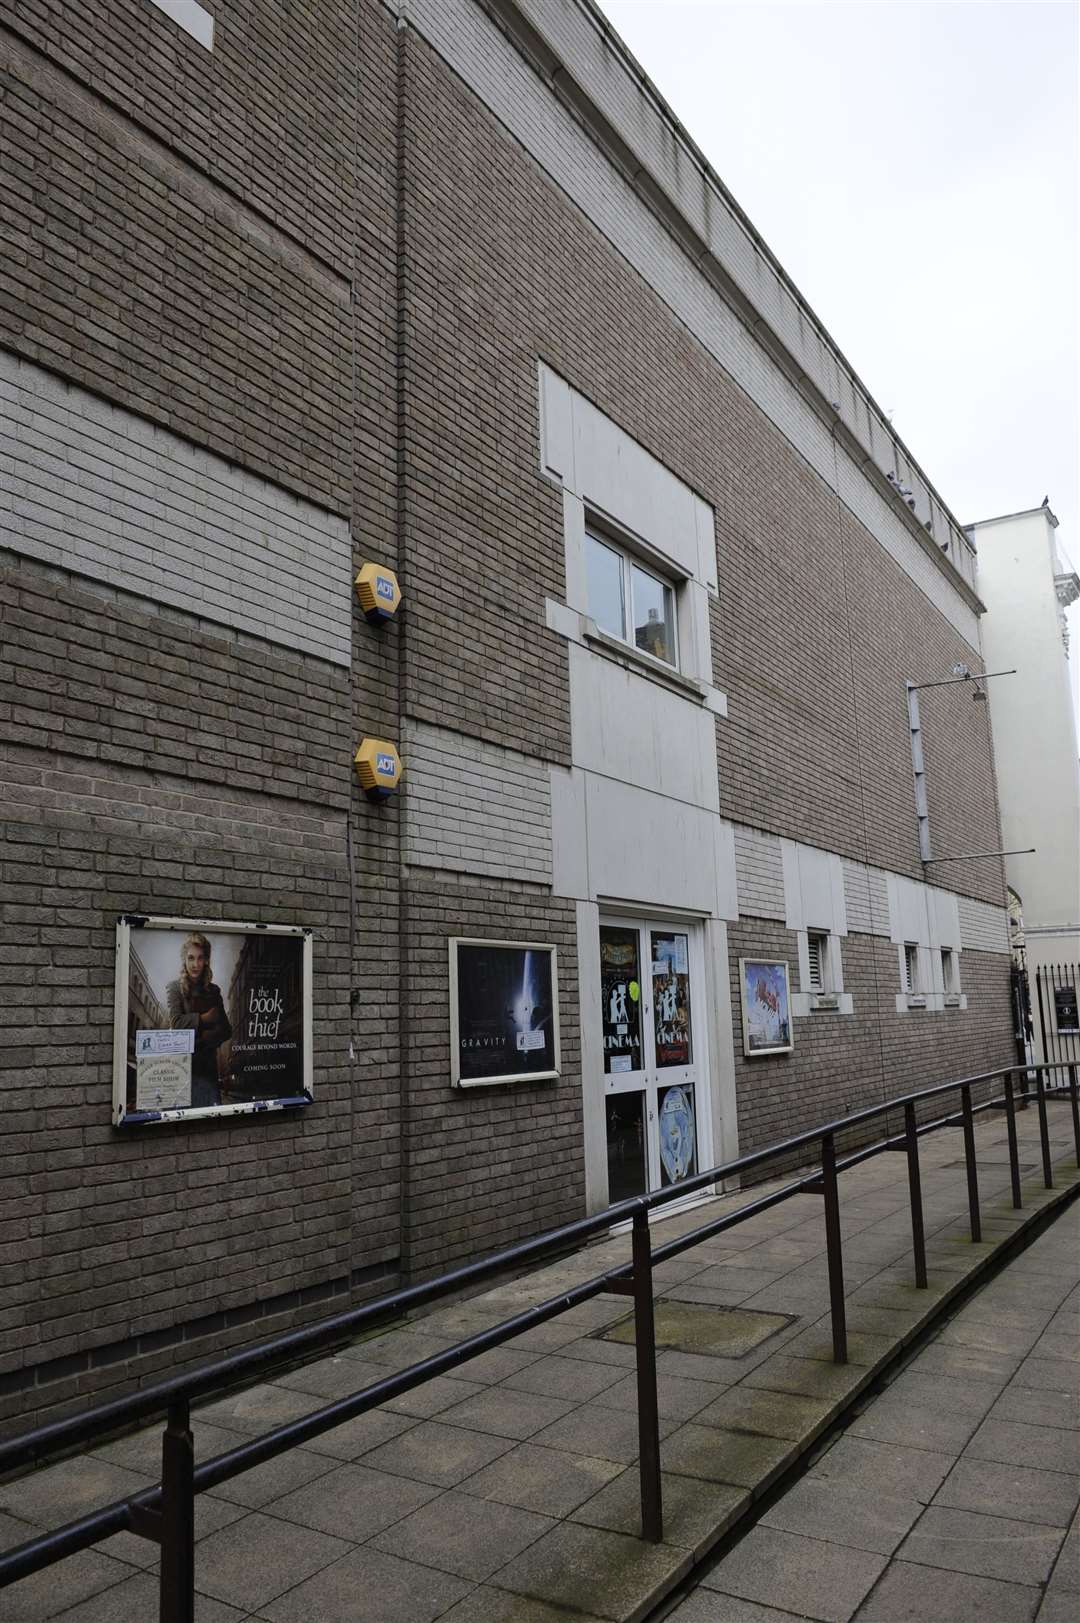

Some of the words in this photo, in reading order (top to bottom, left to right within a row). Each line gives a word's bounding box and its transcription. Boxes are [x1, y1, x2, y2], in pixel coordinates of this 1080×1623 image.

[378, 582, 393, 596] ADT
[378, 759, 394, 772] ADT
[258, 985, 270, 997] the
[249, 988, 284, 1014] book
[248, 1013, 281, 1040] thief
[461, 1037, 506, 1048] GRAVITY
[603, 1034, 640, 1049] CINEMA
[657, 1031, 689, 1044] CINEMA
[243, 1064, 268, 1072] COMING
